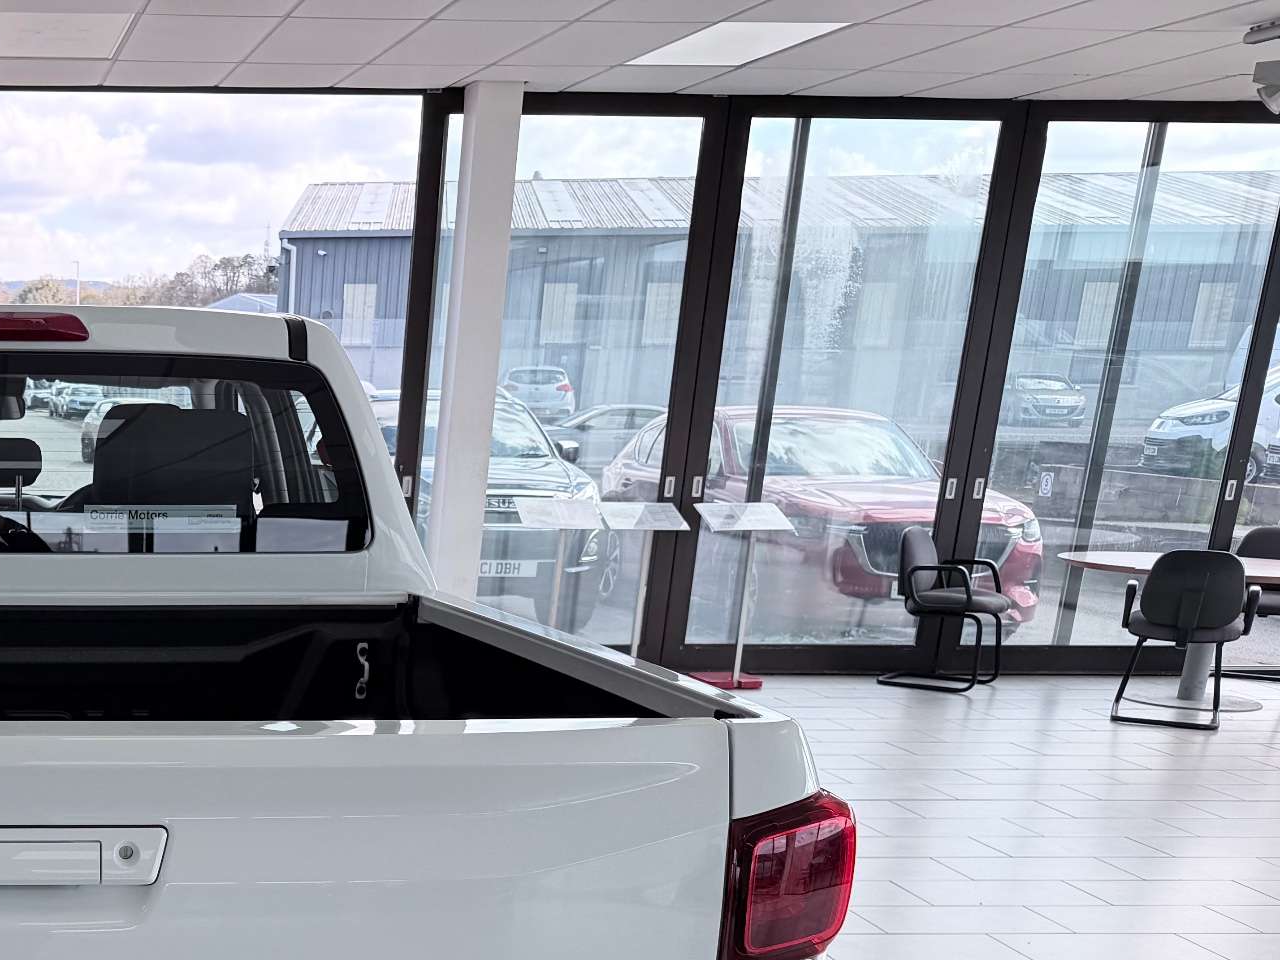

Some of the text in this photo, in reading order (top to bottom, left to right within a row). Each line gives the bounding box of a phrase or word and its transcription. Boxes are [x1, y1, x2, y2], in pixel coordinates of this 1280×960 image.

[90, 509, 169, 520] Corrie Motors
[495, 561, 521, 575] DBH
